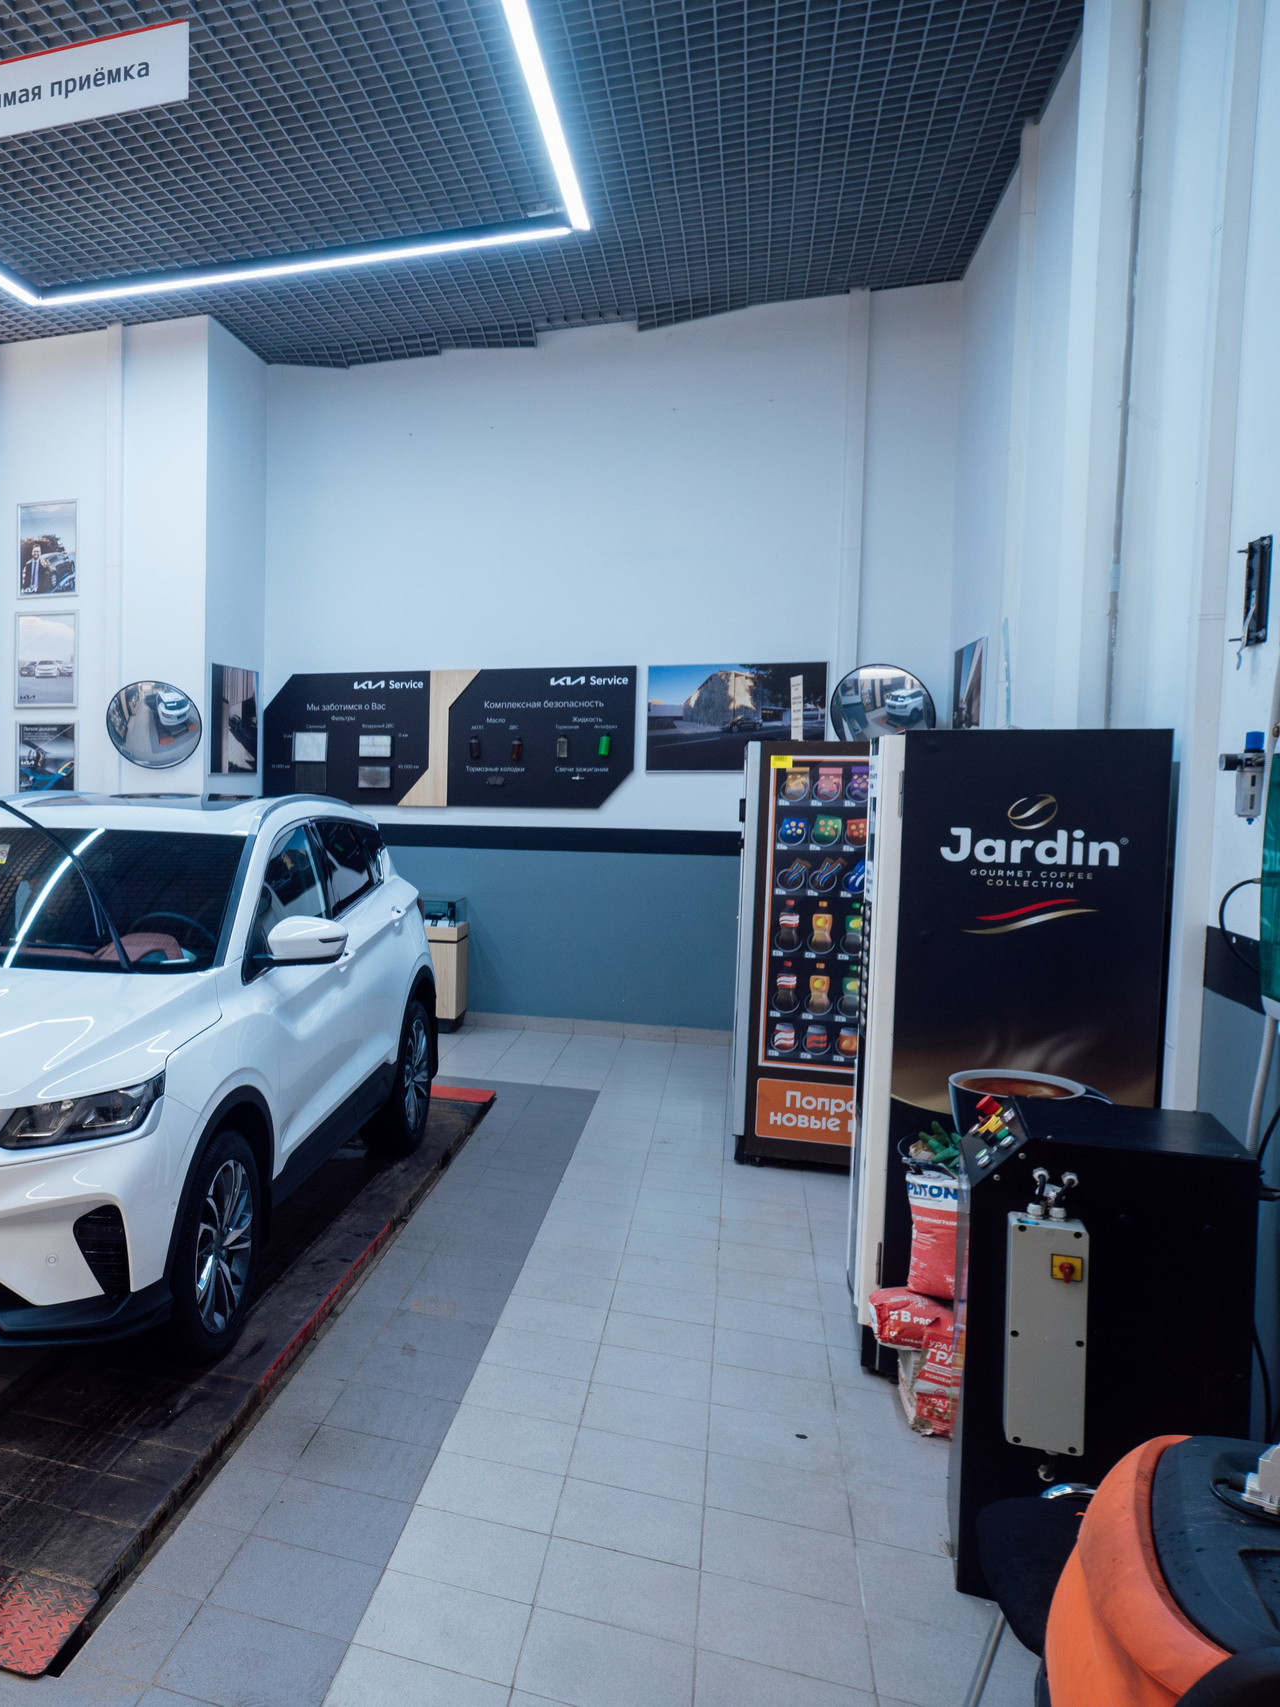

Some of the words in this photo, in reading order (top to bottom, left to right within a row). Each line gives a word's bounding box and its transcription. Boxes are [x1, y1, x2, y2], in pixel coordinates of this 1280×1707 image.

[50, 61, 150, 99] приёмка
[353, 680, 385, 690] KIA
[388, 679, 424, 690] Service
[550, 676, 586, 686] KIA
[589, 675, 629, 685] Service
[306, 703, 320, 711] Мы
[321, 702, 363, 711] заботимся
[371, 702, 386, 711] Вас
[484, 700, 541, 709] Комплексная
[543, 700, 605, 708] безопасность
[940, 827, 1120, 867] Jardin
[970, 869, 1033, 878] GOURMET
[1040, 871, 1093, 880] COFFEE
[987, 879, 1075, 889] COLLECTION
[770, 1112, 841, 1131] новые
[901, 1310, 912, 1322] B
